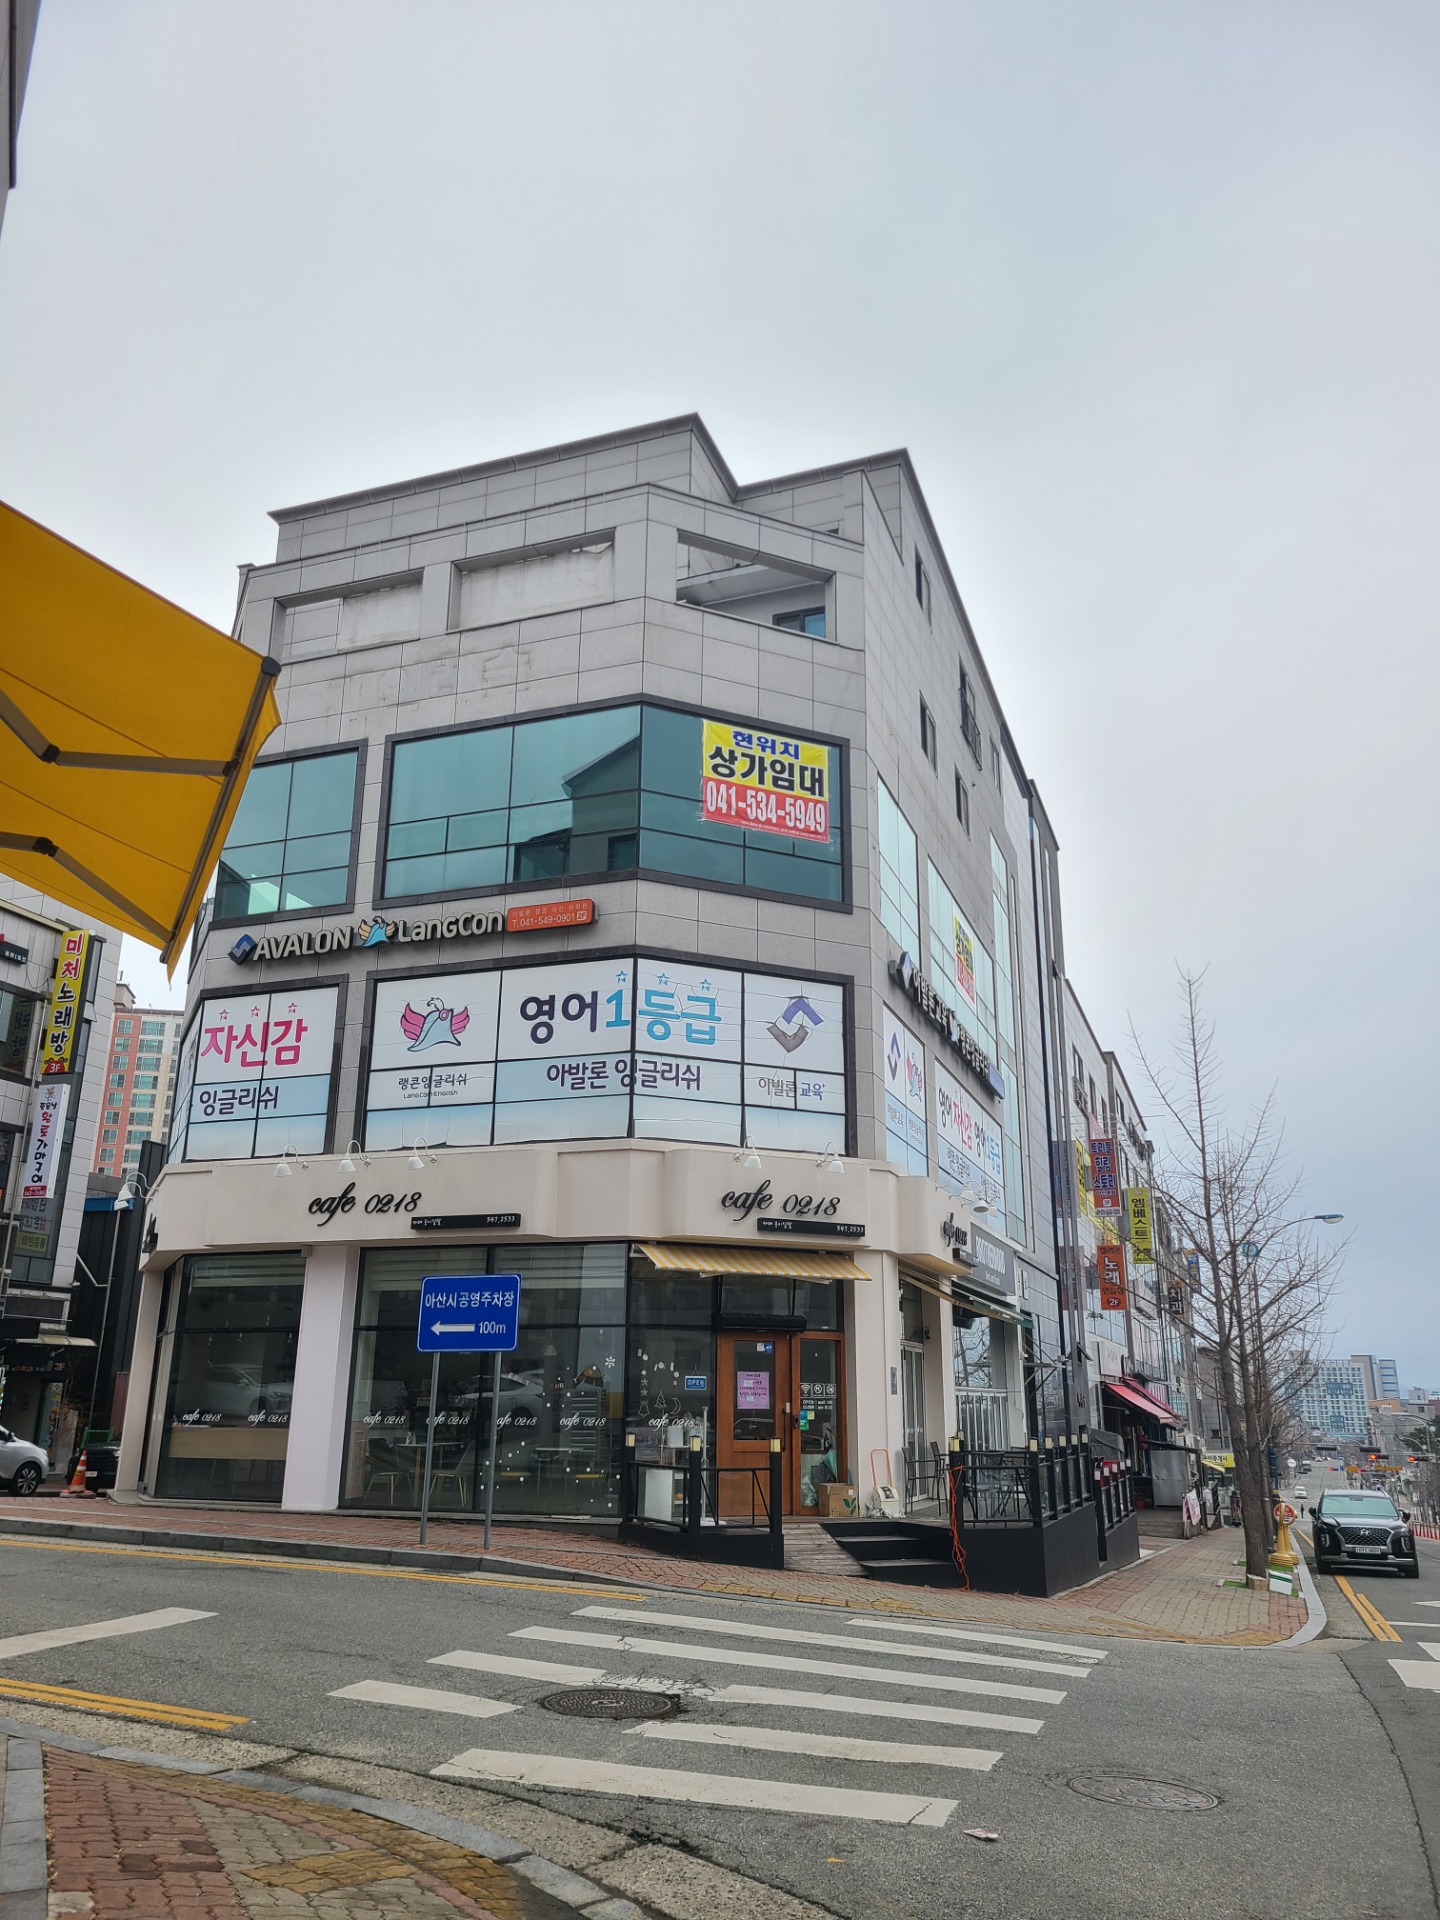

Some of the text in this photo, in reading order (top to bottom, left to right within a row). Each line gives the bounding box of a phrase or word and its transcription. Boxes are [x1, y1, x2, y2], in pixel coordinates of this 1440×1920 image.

[733, 730, 800, 760] 현위치
[708, 746, 825, 797] 상가임대
[706, 781, 826, 833] 041-534-5949
[253, 926, 353, 961] AVALON
[201, 1018, 308, 1068] 자신감
[50, 1063, 61, 1073] 3F
[546, 1059, 701, 1091] 아발론 잉글리쉬
[200, 1085, 279, 1117] 잉글리쉬
[308, 1182, 422, 1227] cafe 0218
[721, 1180, 841, 1222] cafe 0218
[1108, 1298, 1119, 1306] 2F
[479, 1321, 506, 1334] 100m
[182, 1408, 222, 1425] cafe 0218
[247, 1409, 289, 1427] cafe 0218
[363, 1410, 406, 1429] cafe 0218
[447, 1416, 470, 1425] 0218
[514, 1416, 538, 1426] 0218
[560, 1412, 607, 1431] cafe 0218
[648, 1413, 695, 1432] cafe 0218
